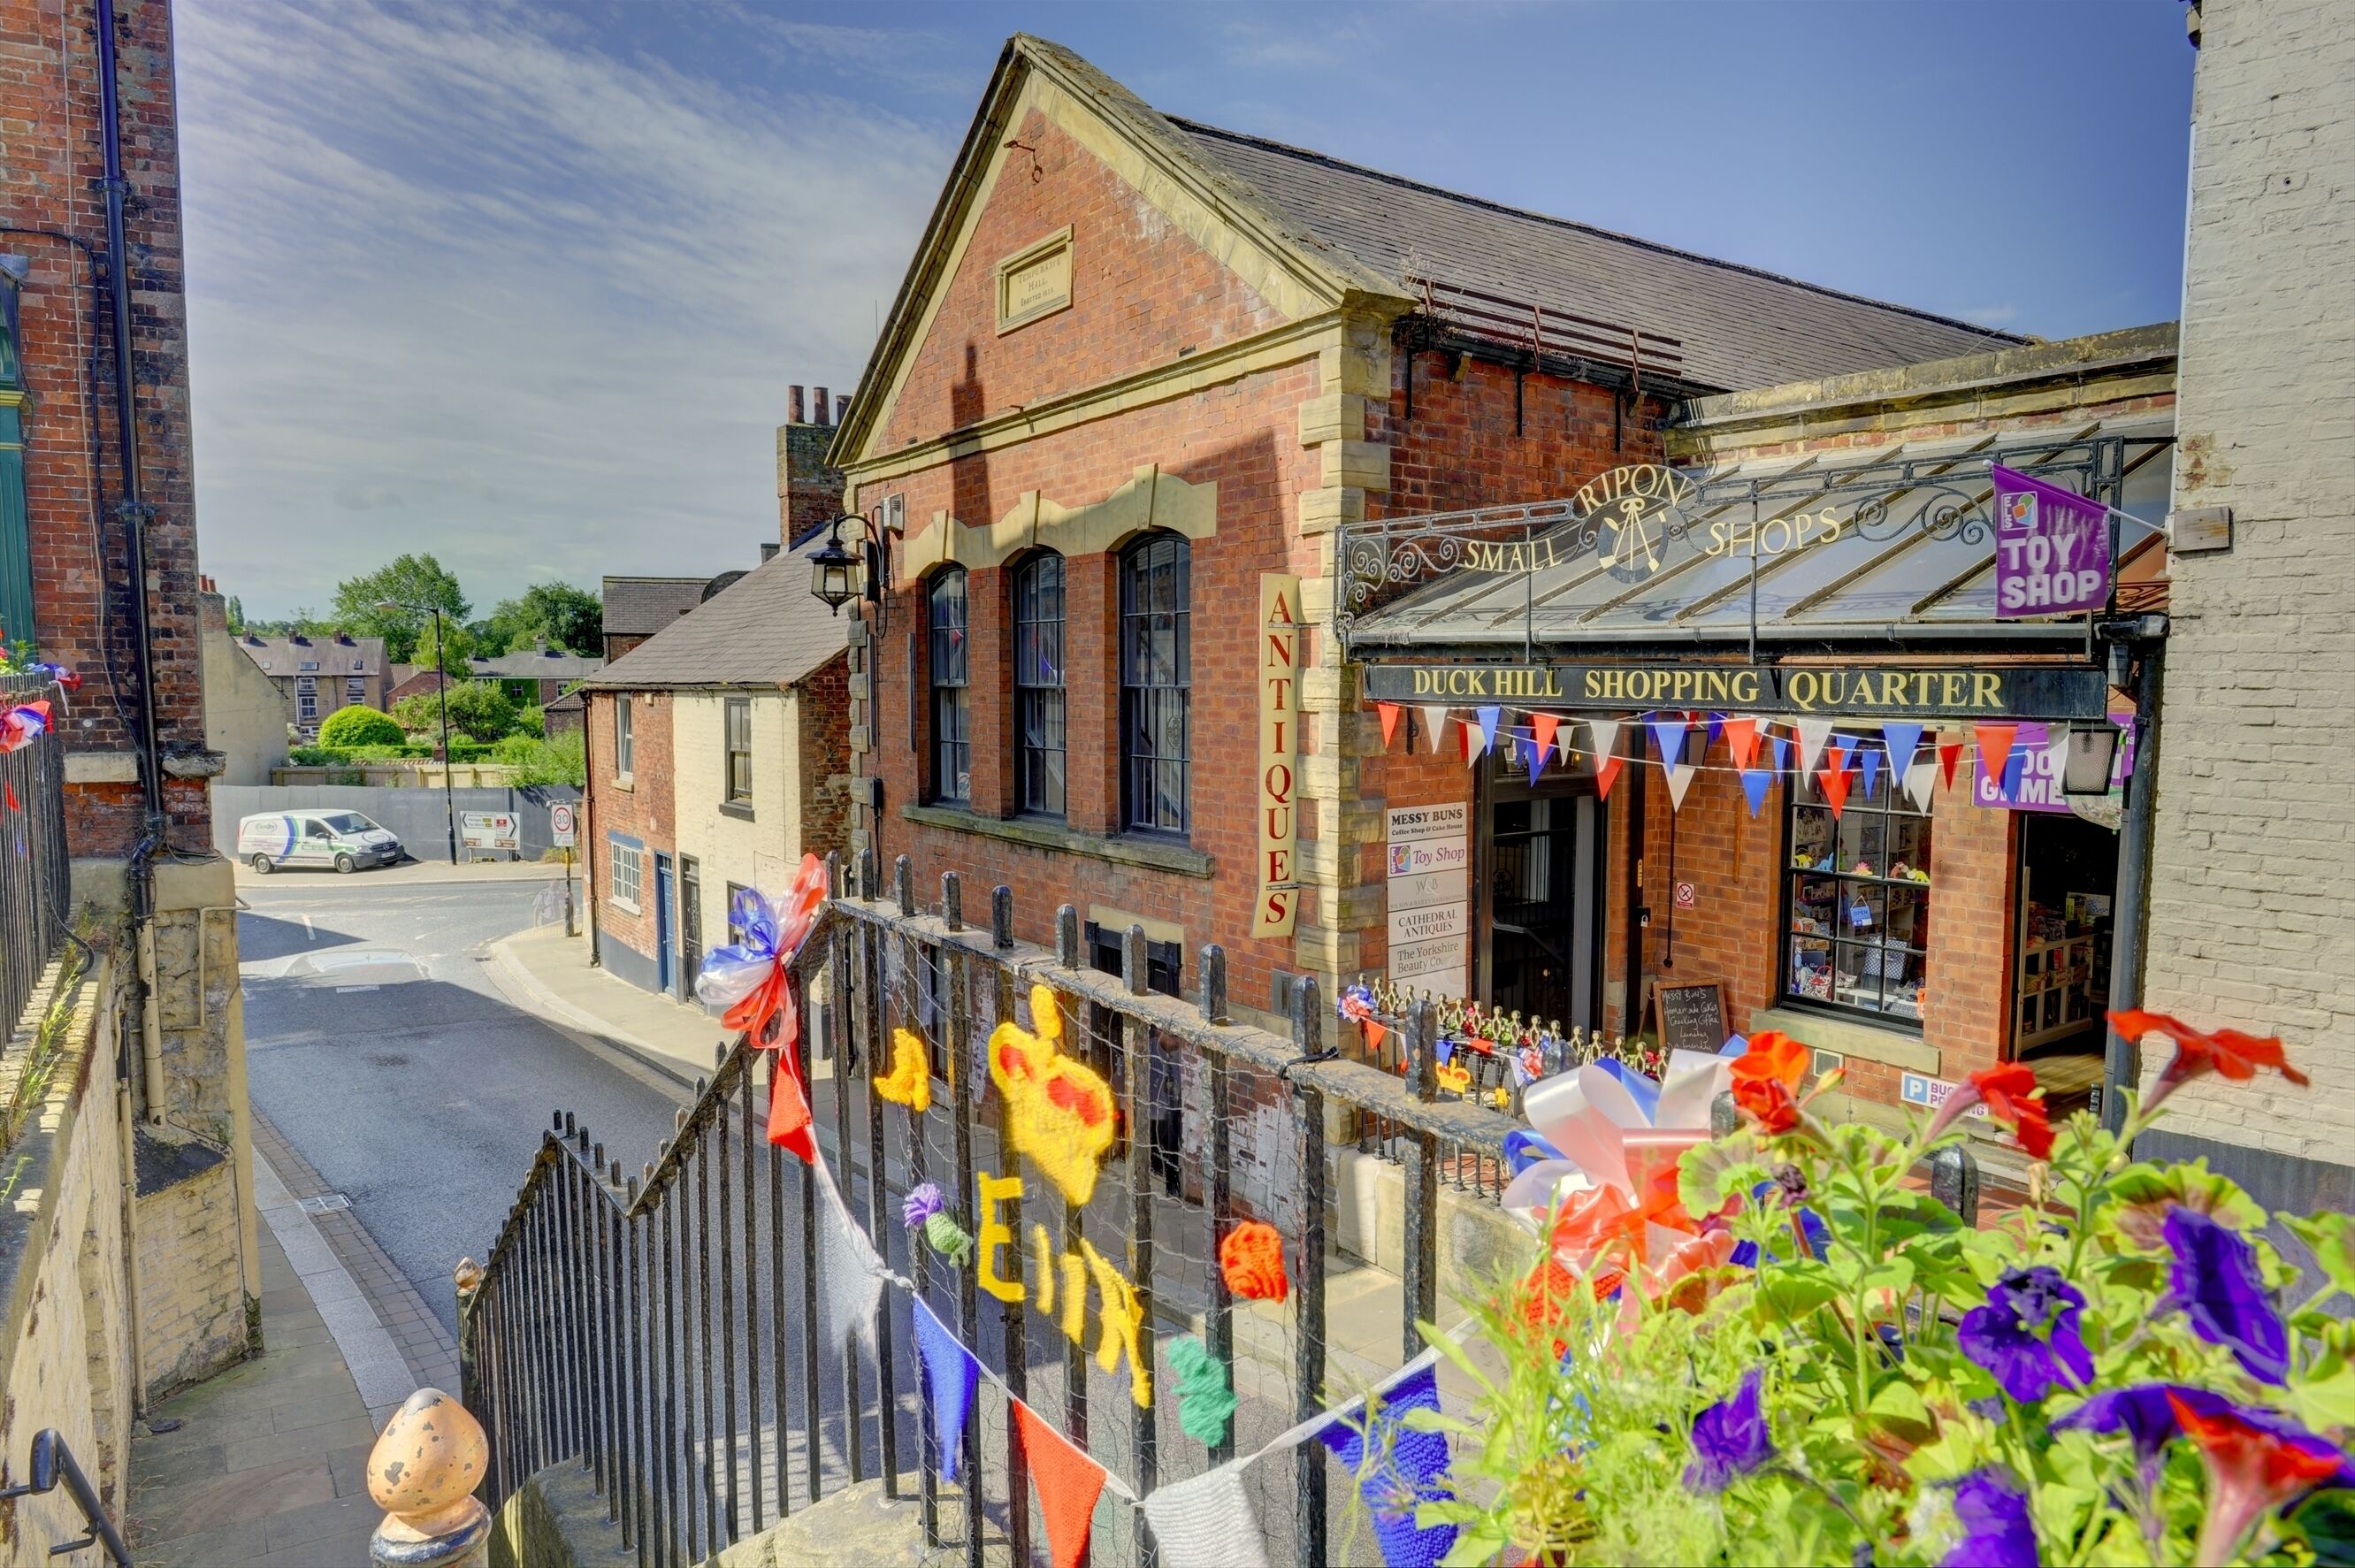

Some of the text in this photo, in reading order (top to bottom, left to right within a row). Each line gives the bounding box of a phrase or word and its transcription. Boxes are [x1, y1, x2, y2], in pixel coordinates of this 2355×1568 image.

[1579, 464, 1686, 516] RIPON
[1464, 506, 1841, 573] SMALL SHOPS
[2000, 533, 2076, 570] TOY
[2000, 570, 2101, 608] SHOP
[1414, 670, 2005, 710] DUCK HILL SHOPPING QUARTER
[1265, 590, 1292, 925] ANTIQUES
[556, 815, 569, 824] 30
[1391, 809, 1463, 826] MESSY BUNS
[1413, 847, 1465, 867] Toy Shop
[1398, 909, 1457, 927] CATHEDRAL
[1404, 921, 1453, 937] ANTIQUES
[1397, 942, 1459, 961] The Yorkshire
[1397, 956, 1443, 973] Beauty Co.
[1909, 1079, 1923, 1098] P
